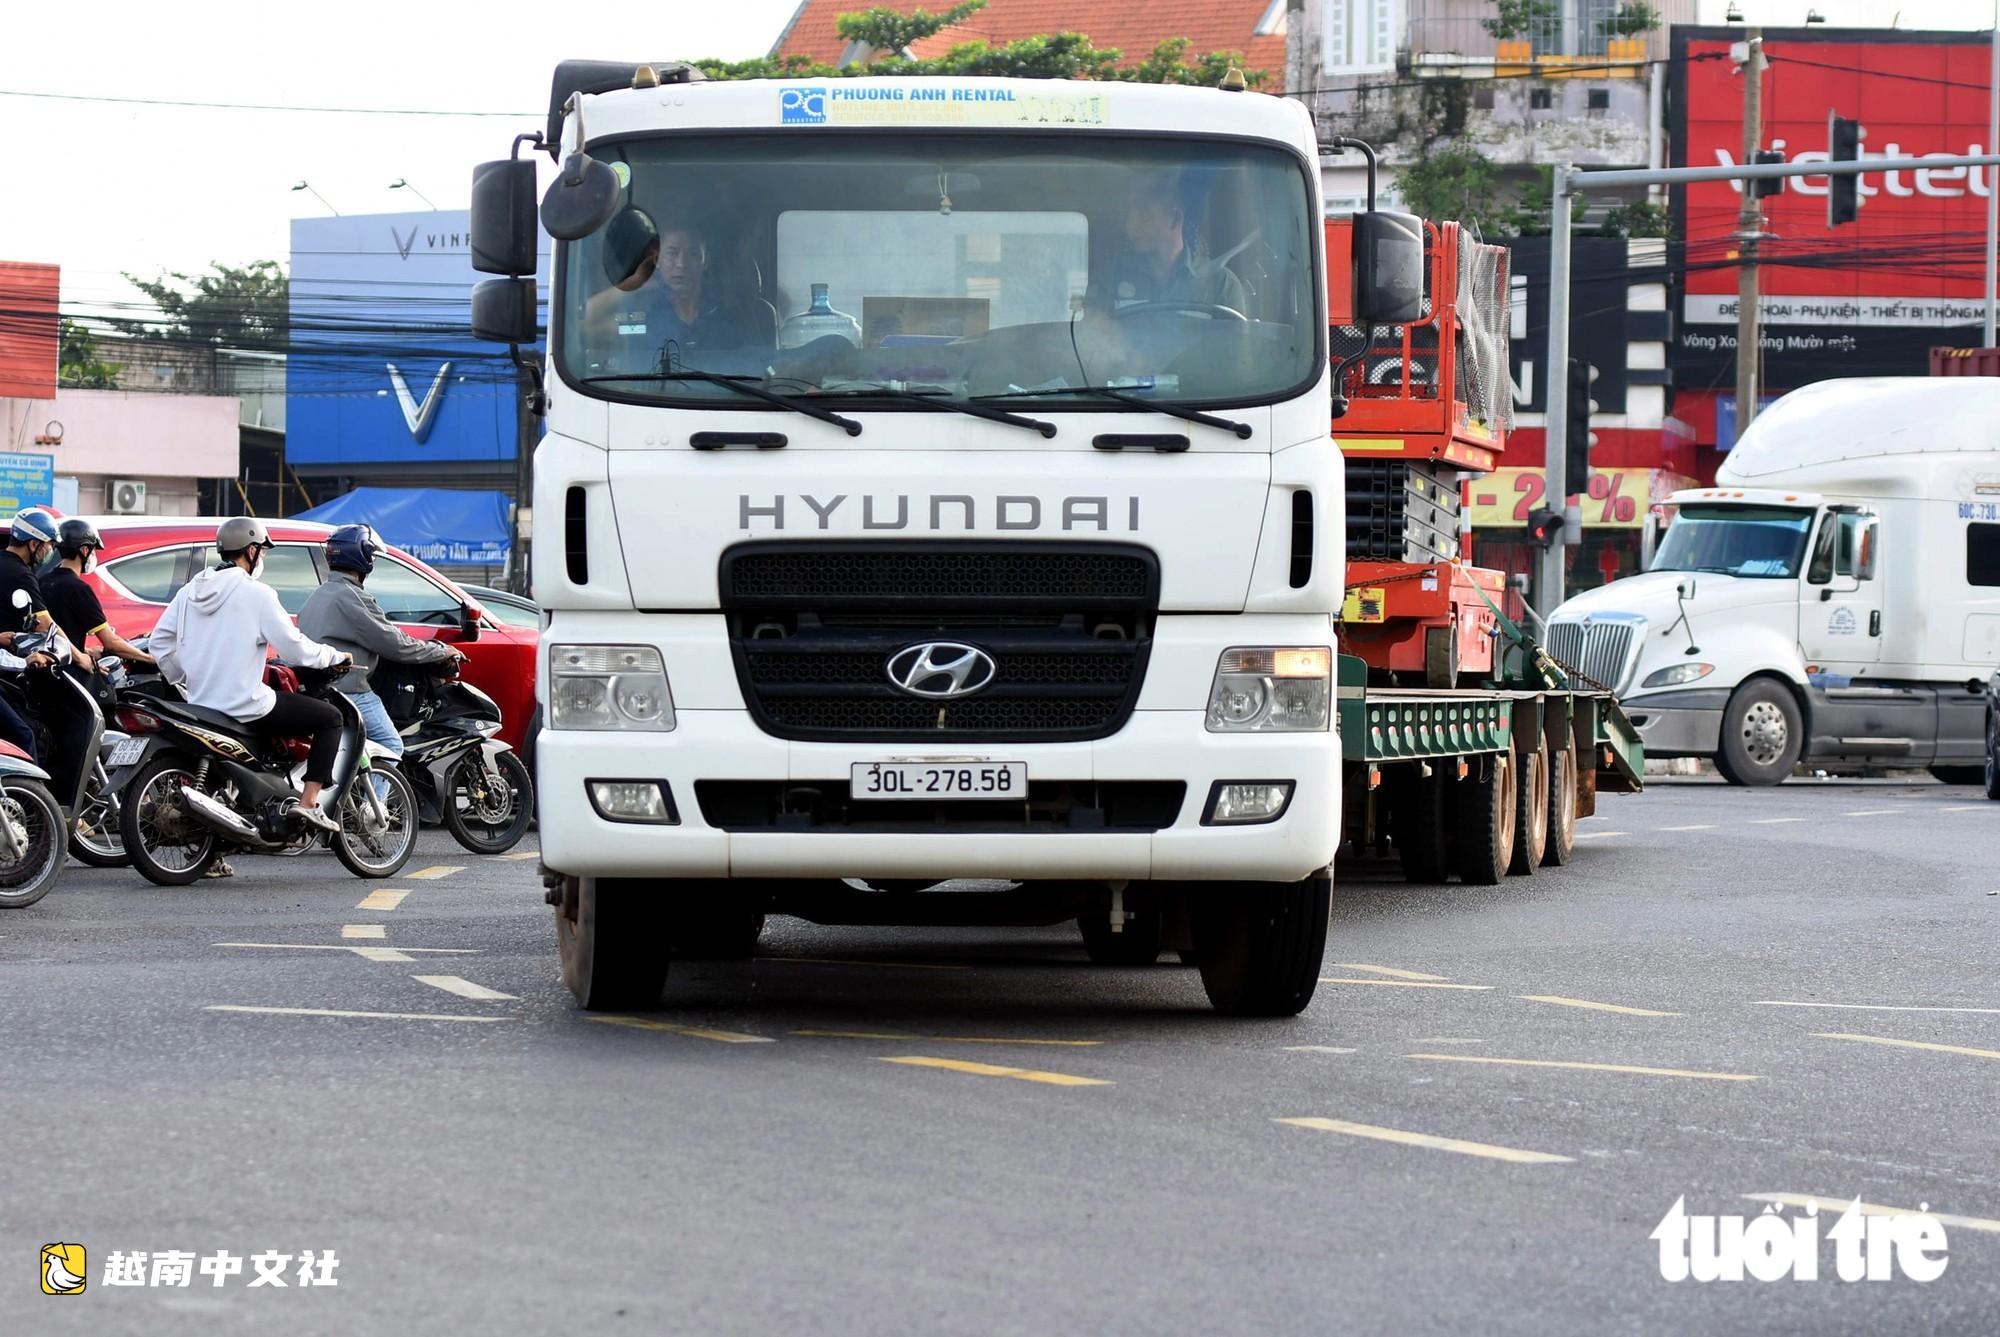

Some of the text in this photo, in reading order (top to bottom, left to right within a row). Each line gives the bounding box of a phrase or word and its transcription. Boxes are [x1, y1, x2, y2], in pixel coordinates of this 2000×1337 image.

[832, 88, 1016, 101] PHUONG ANH RENTAL
[1758, 304, 1792, 318] HOẠI
[1830, 302, 1860, 319] KIỆN
[1870, 300, 1908, 318] THIẾT
[1926, 304, 1972, 318] THÔNG
[1683, 334, 1716, 350] Vòng
[739, 495, 1139, 530] HYUNDAI
[867, 769, 1011, 792] 30L-278.58
